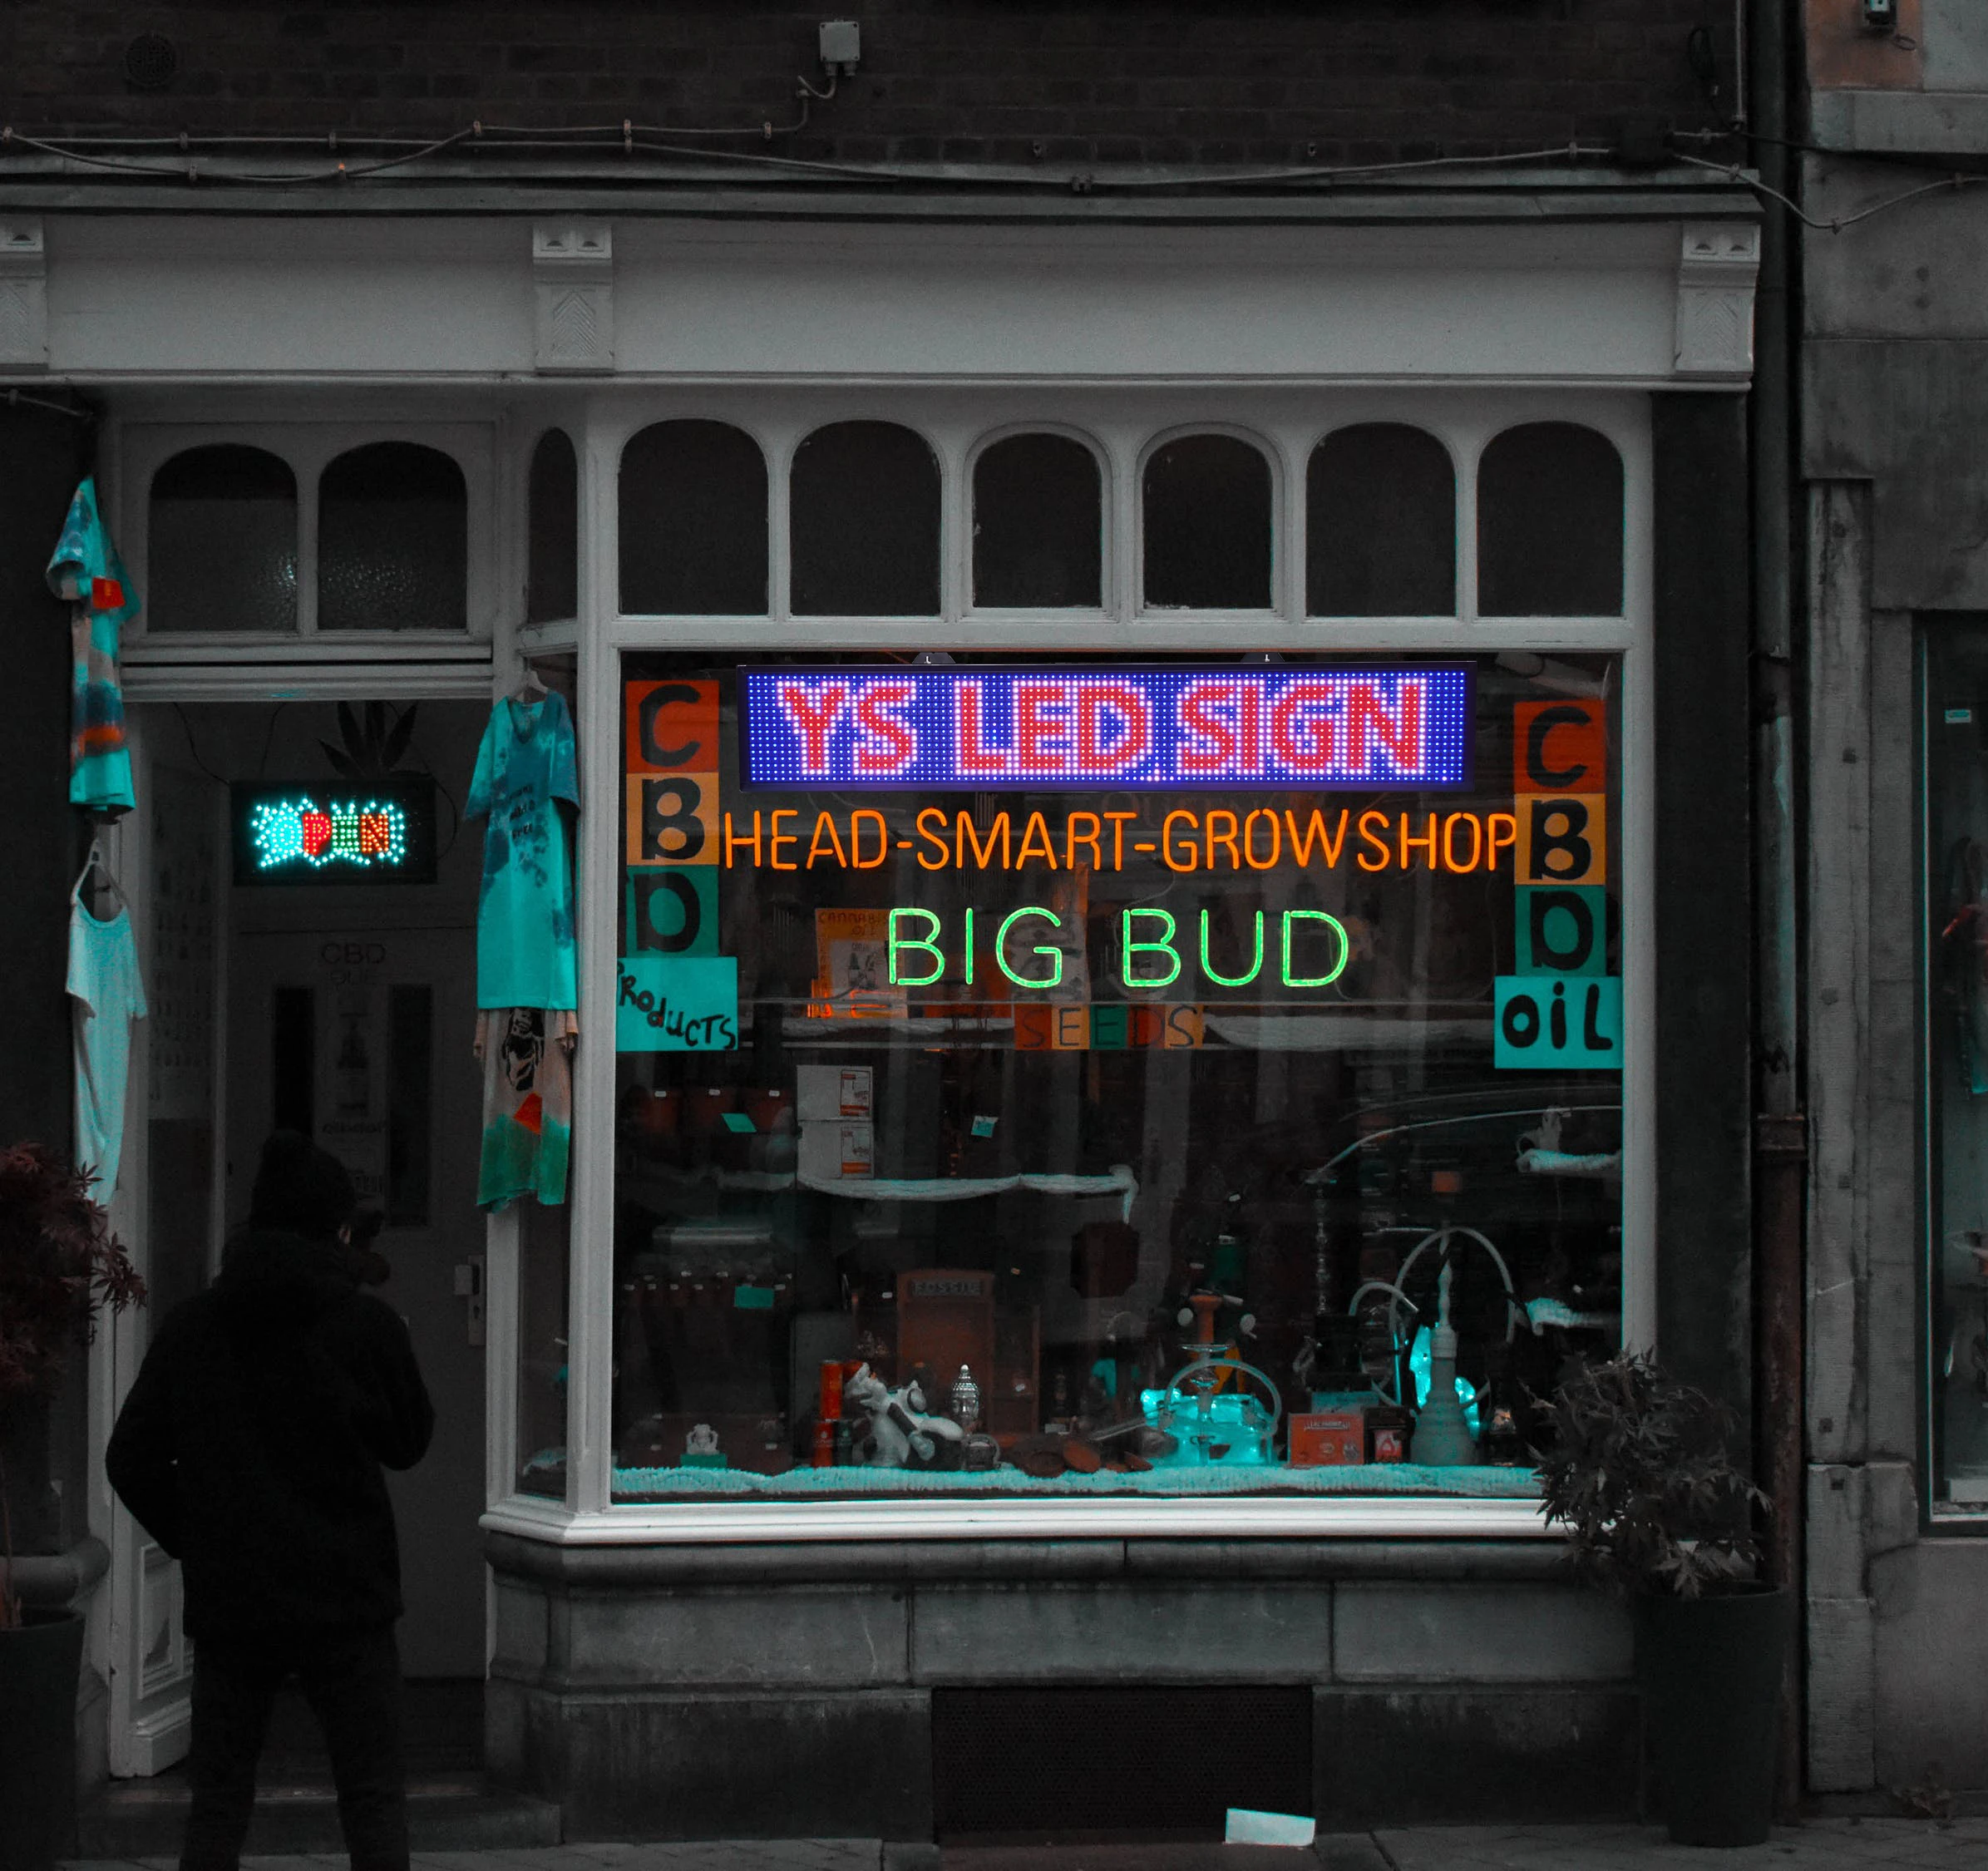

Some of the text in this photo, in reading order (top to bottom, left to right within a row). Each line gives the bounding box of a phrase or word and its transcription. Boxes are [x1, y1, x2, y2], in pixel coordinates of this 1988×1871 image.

[777, 677, 1428, 777] YS LED SIGN
[268, 811, 391, 856] OPEN
[638, 684, 706, 953] CBD
[1527, 705, 1594, 971] CBD
[321, 942, 387, 965] CBD
[887, 906, 1349, 990] BIG BUD
[1022, 1003, 1198, 1049] SEEDS
